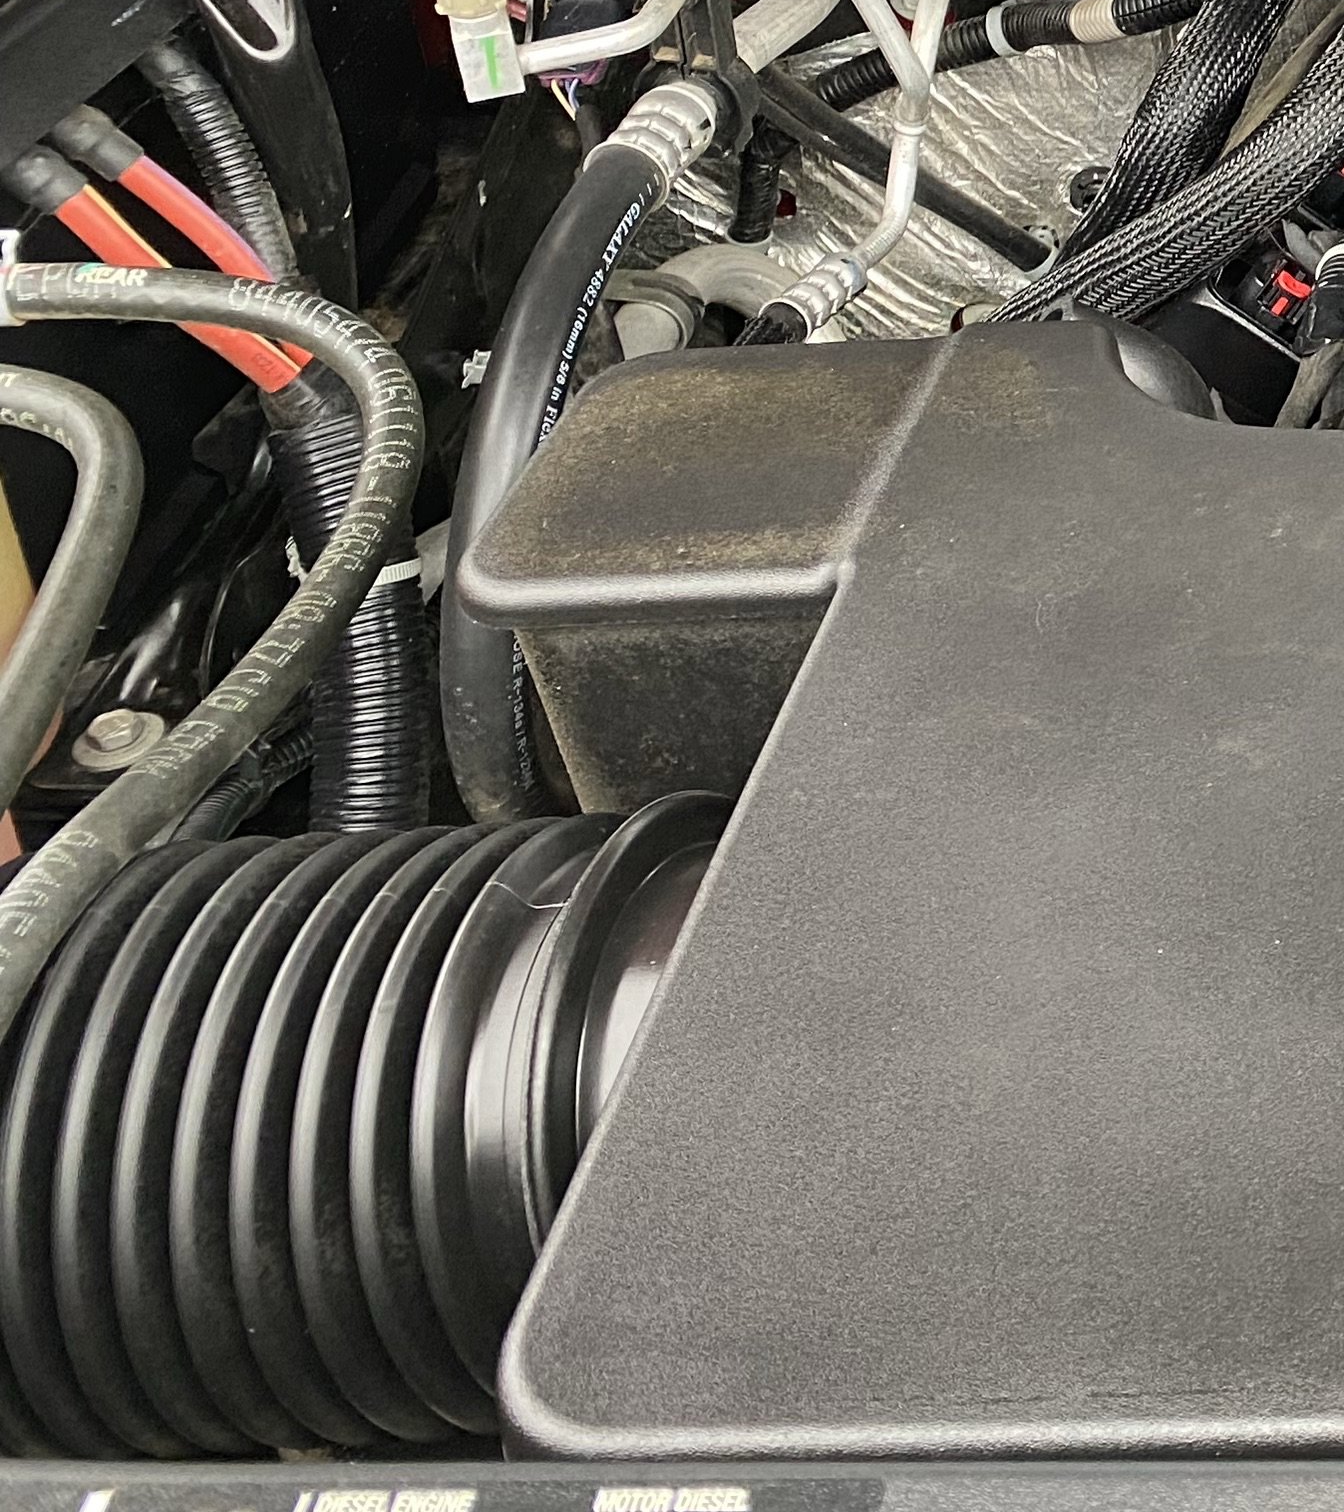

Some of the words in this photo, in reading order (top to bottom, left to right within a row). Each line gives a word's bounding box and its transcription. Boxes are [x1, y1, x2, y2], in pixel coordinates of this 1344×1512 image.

[602, 202, 641, 271] GALAXY
[75, 268, 148, 286] REAR
[583, 268, 605, 307] 4882
[562, 306, 588, 360] (16mm)
[513, 636, 527, 674] OSE
[314, 1489, 390, 1512] DIESEL
[391, 1489, 477, 1512] ENGINE
[593, 1489, 673, 1512] MOTOR
[674, 1489, 751, 1512] DIESEL
